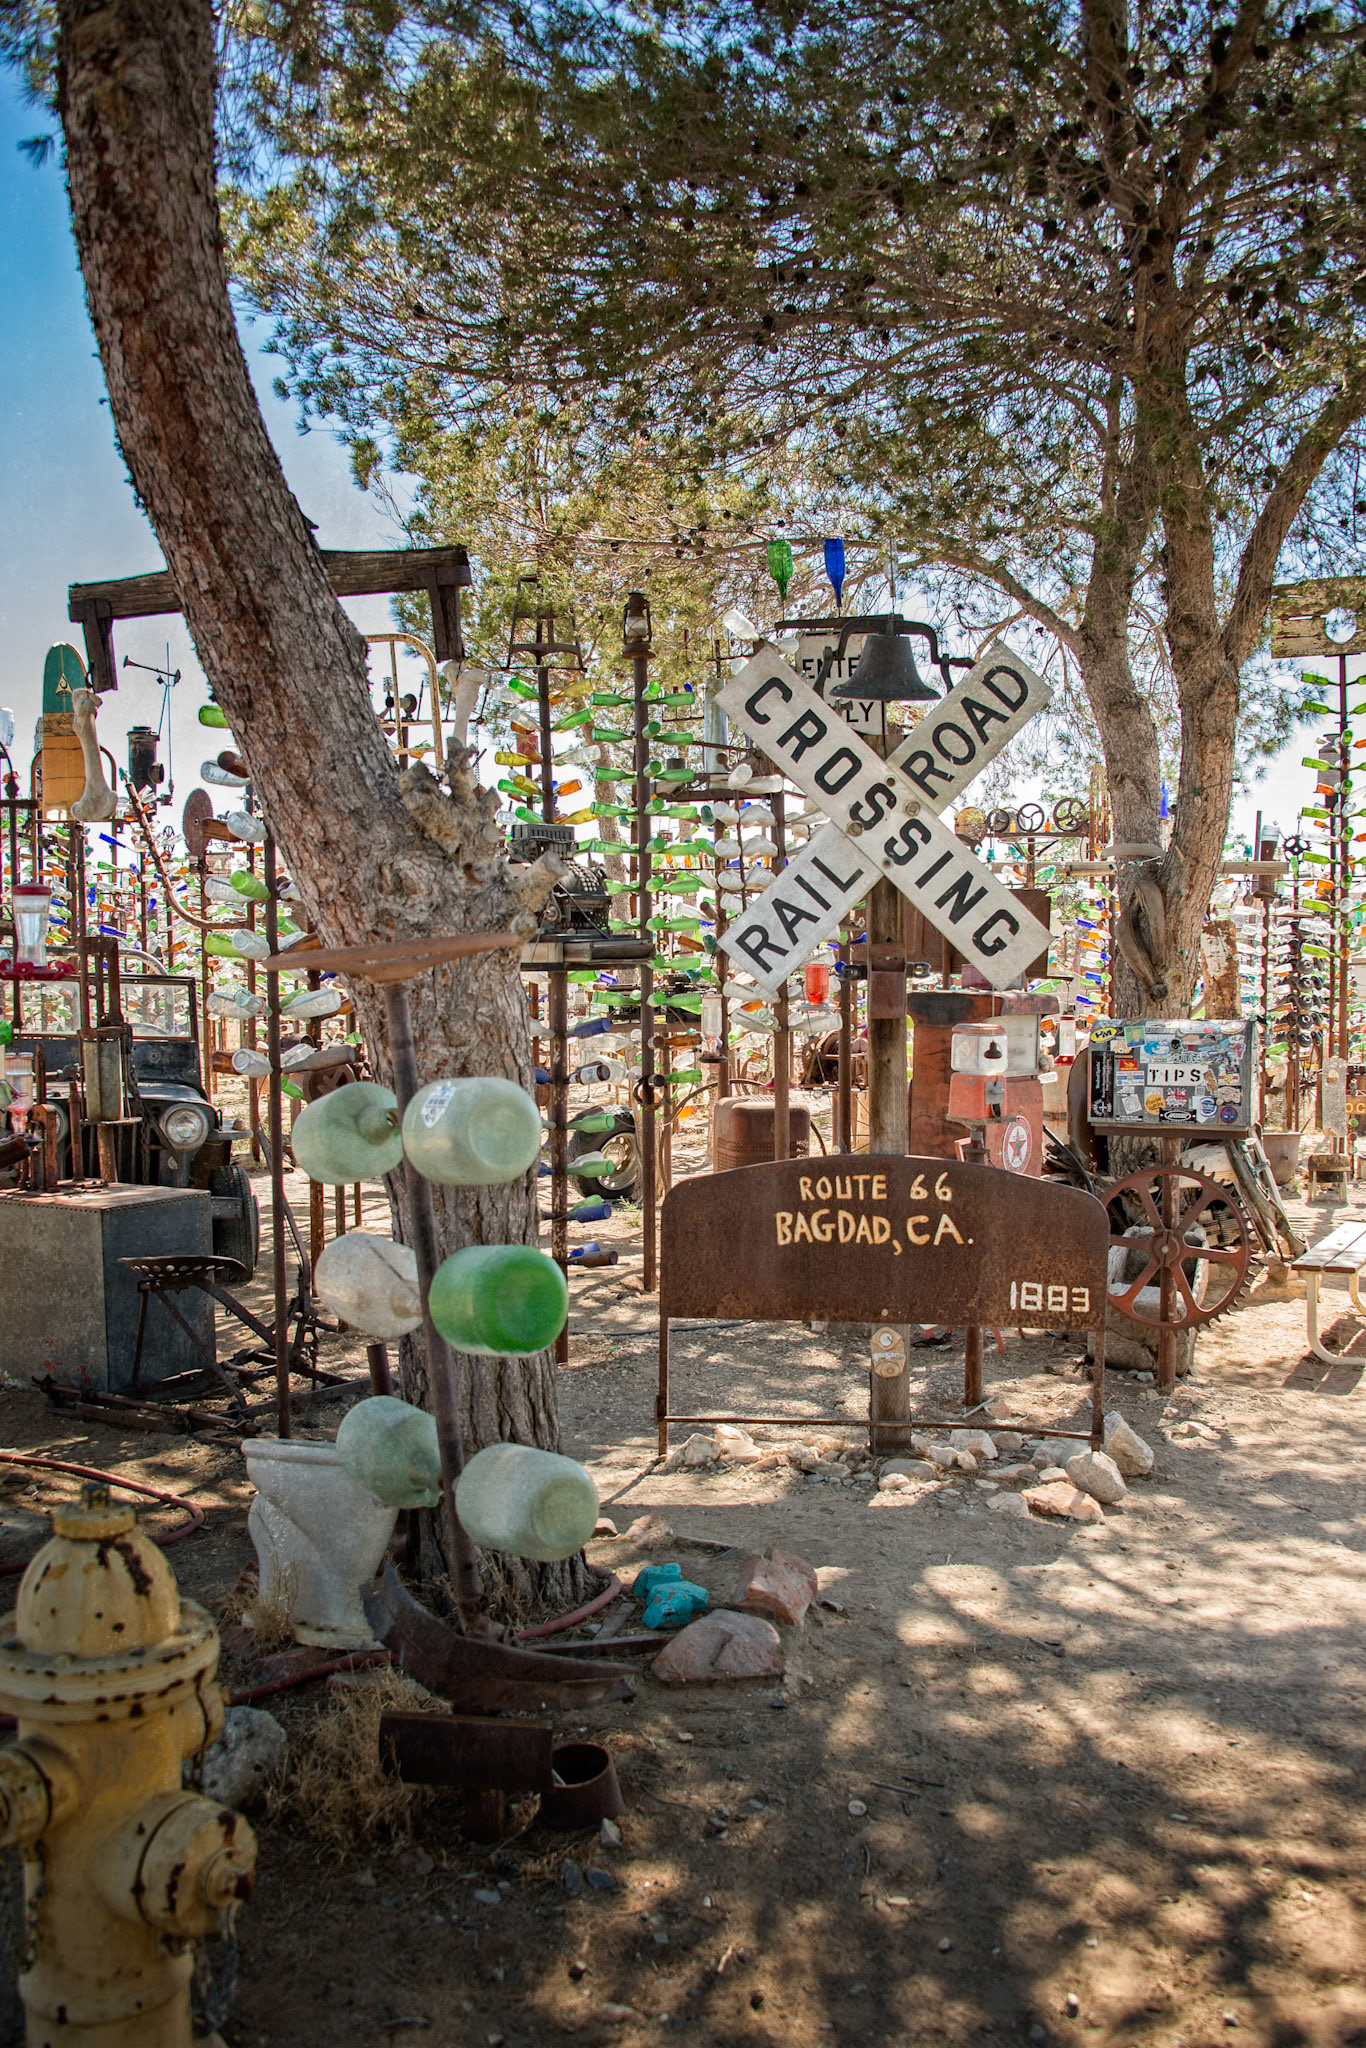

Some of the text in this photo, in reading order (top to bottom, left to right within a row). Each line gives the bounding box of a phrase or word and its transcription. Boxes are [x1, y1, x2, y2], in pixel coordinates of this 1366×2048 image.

[802, 656, 861, 679] ENTE
[735, 664, 1029, 974] RAIL ROAD
[744, 676, 1020, 958] CROSSING
[1149, 1068, 1201, 1082] TIPS
[799, 1172, 953, 1201] ROUTE 66
[1010, 1281, 1091, 1312] 1883
